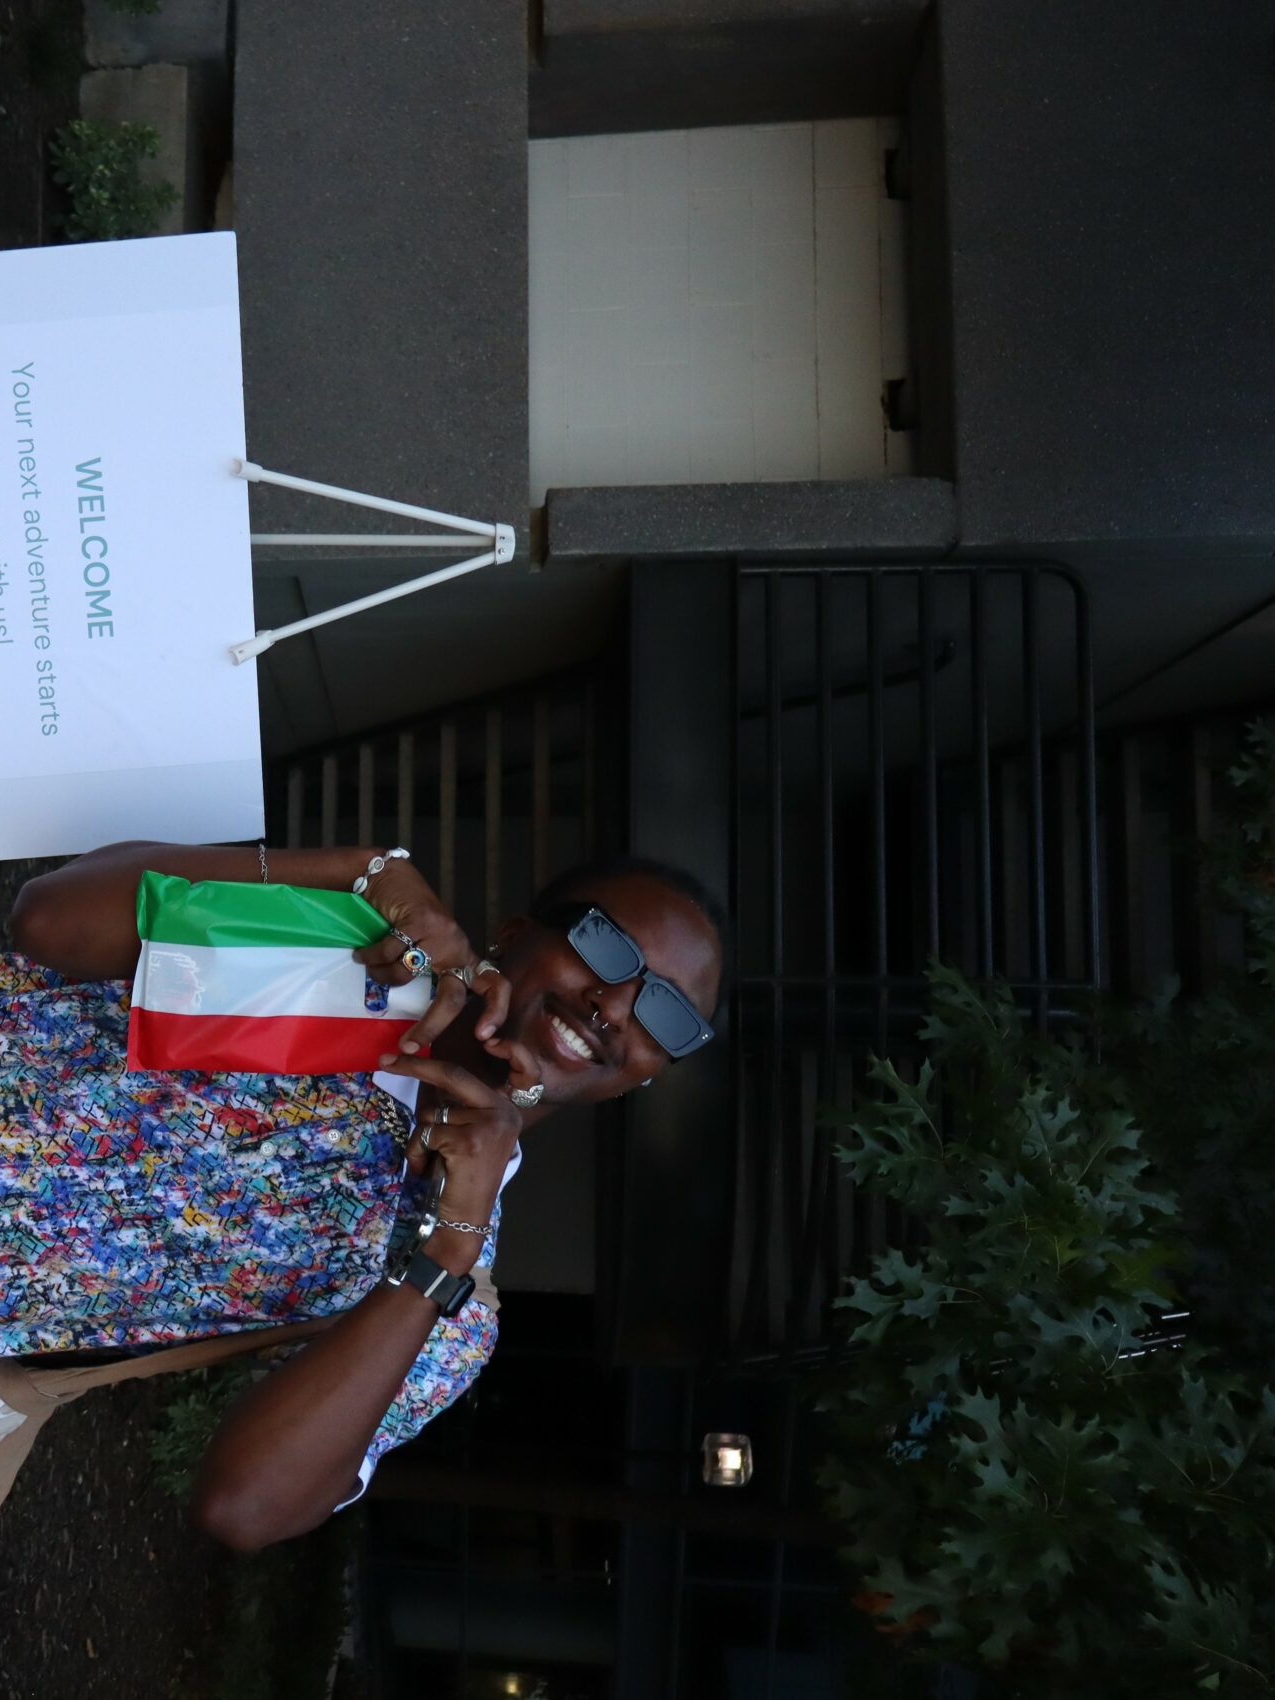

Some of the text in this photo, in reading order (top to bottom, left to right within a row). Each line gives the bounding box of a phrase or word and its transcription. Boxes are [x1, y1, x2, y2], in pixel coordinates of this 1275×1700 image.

[11, 361, 59, 736] Your next adventure starts
[75, 457, 114, 639] WELCOME
